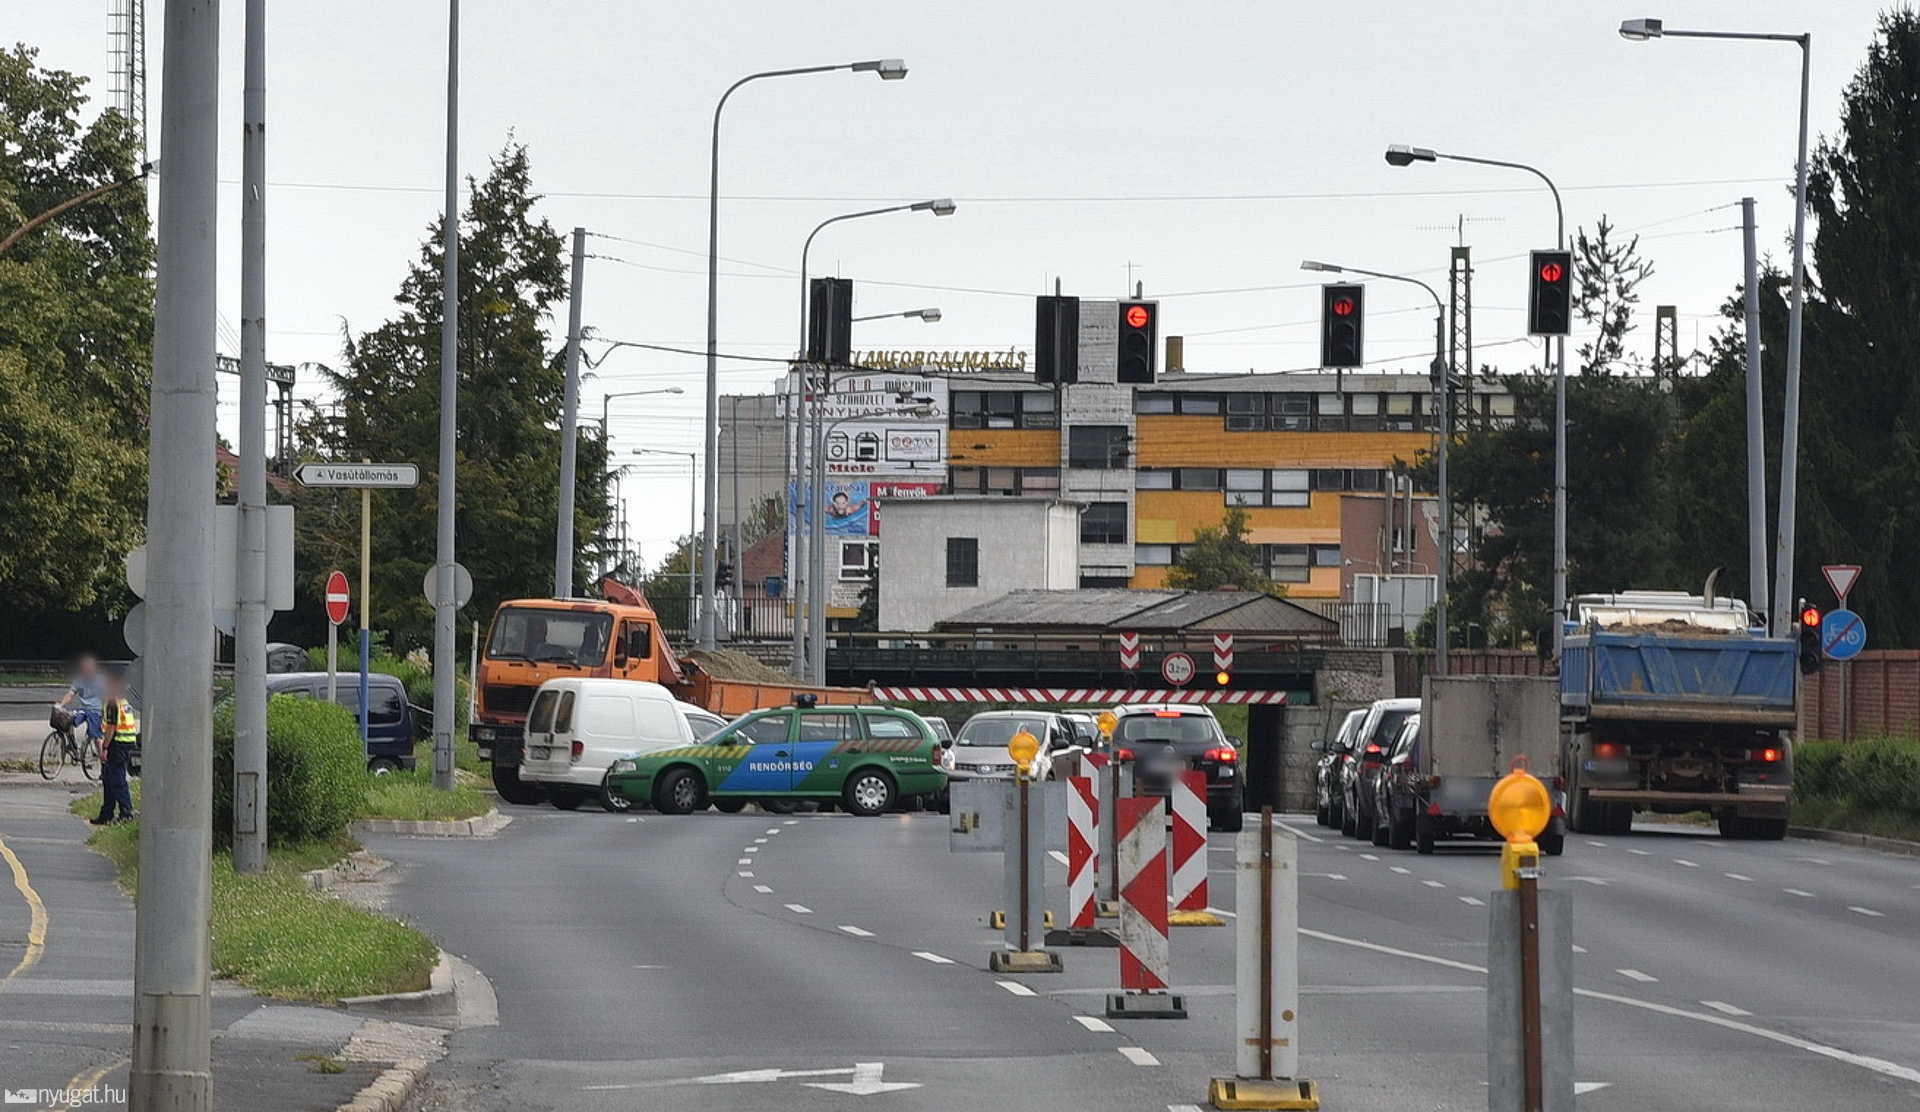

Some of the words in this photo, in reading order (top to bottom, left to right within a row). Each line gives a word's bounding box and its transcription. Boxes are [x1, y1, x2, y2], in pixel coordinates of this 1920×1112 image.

[828, 463, 875, 473] Miele
[328, 469, 399, 481] Vasútállomás
[750, 761, 813, 772] RENDŐRSÉG
